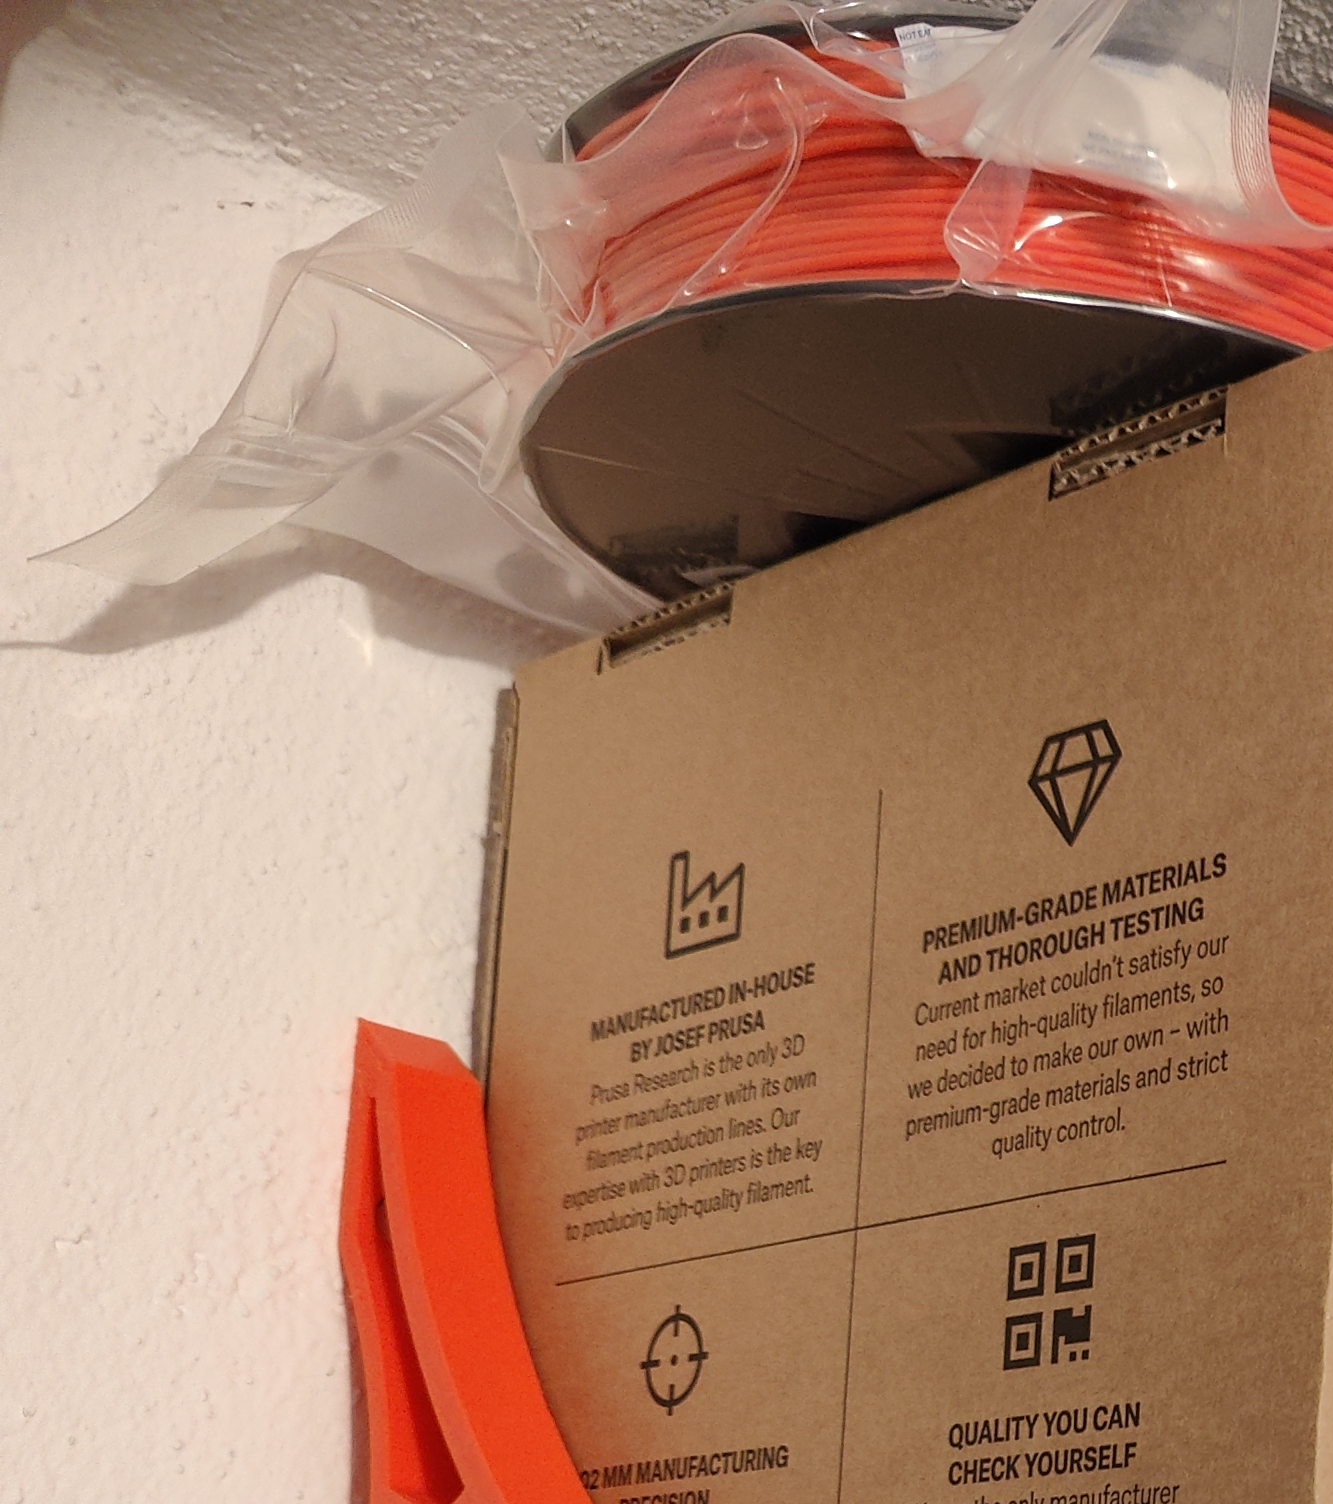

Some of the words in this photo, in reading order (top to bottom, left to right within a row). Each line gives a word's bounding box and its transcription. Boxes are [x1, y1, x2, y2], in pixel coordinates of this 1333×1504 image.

[922, 885, 1097, 954] PREMIUM-GRADE
[1102, 852, 1226, 907] MATERIALS
[937, 953, 981, 985] AND
[985, 920, 1105, 972] THOROUGH
[1110, 896, 1204, 941] TESTING
[590, 986, 725, 1041] MANUFACTURED
[728, 962, 815, 1005] IN-HOUSE
[914, 991, 980, 1026] Current
[984, 975, 1046, 1010] market
[1050, 954, 1124, 994] couldn't
[1128, 938, 1192, 975] satisfy
[1196, 934, 1229, 959] our
[915, 1029, 957, 1062] need
[962, 1026, 987, 1051] for
[991, 1002, 1098, 1046] high-quality
[1102, 980, 1195, 1019] filaments,
[1200, 975, 1223, 997] so
[630, 1038, 652, 1063] BY
[654, 1024, 705, 1057] JOSEF
[707, 1009, 765, 1044] PRUSA
[905, 1087, 1040, 1141] premium-grade
[1045, 1069, 1130, 1107] materials
[1135, 1058, 1172, 1089] and
[1176, 1049, 1228, 1080] strict
[991, 1124, 1052, 1160] quality
[1056, 1107, 1126, 1143] control.
[948, 1412, 1039, 1450] QUALITY
[1042, 1406, 1088, 1437] YOU
[1092, 1401, 1140, 1431] CAN
[948, 1454, 1020, 1486] CHECK
[1024, 1441, 1137, 1478] YOURSELF
[602, 1463, 632, 1488] MM
[635, 1444, 789, 1484] MANUFACTURING
